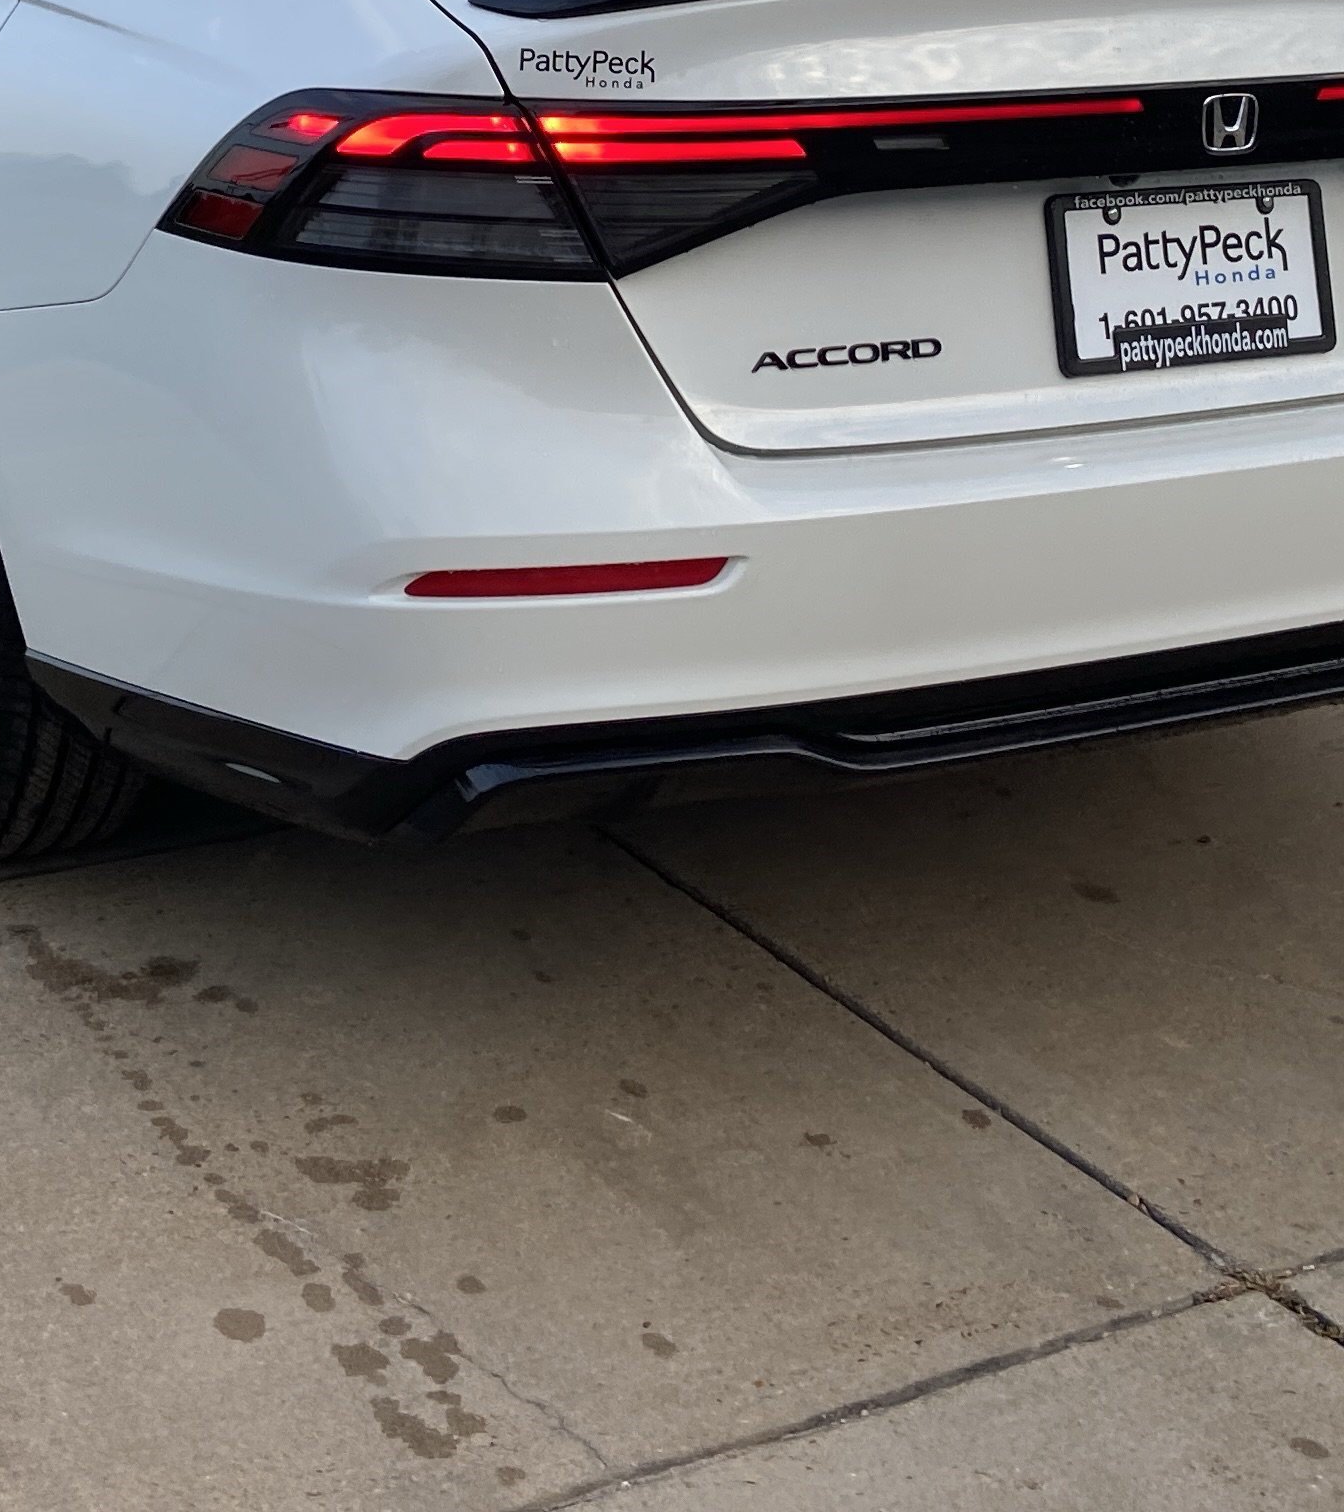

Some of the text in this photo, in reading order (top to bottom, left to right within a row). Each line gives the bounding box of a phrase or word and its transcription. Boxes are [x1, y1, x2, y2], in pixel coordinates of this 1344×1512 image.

[520, 48, 655, 82] PattyPeck
[586, 77, 644, 89] Honda
[1074, 183, 1302, 209] facebook.com/pattypeckhonda
[1097, 217, 1289, 280] PattyPeck
[1195, 265, 1276, 286] Honda
[751, 338, 942, 373] ACCORD
[1120, 323, 1288, 371] pattypeckhonda.com
